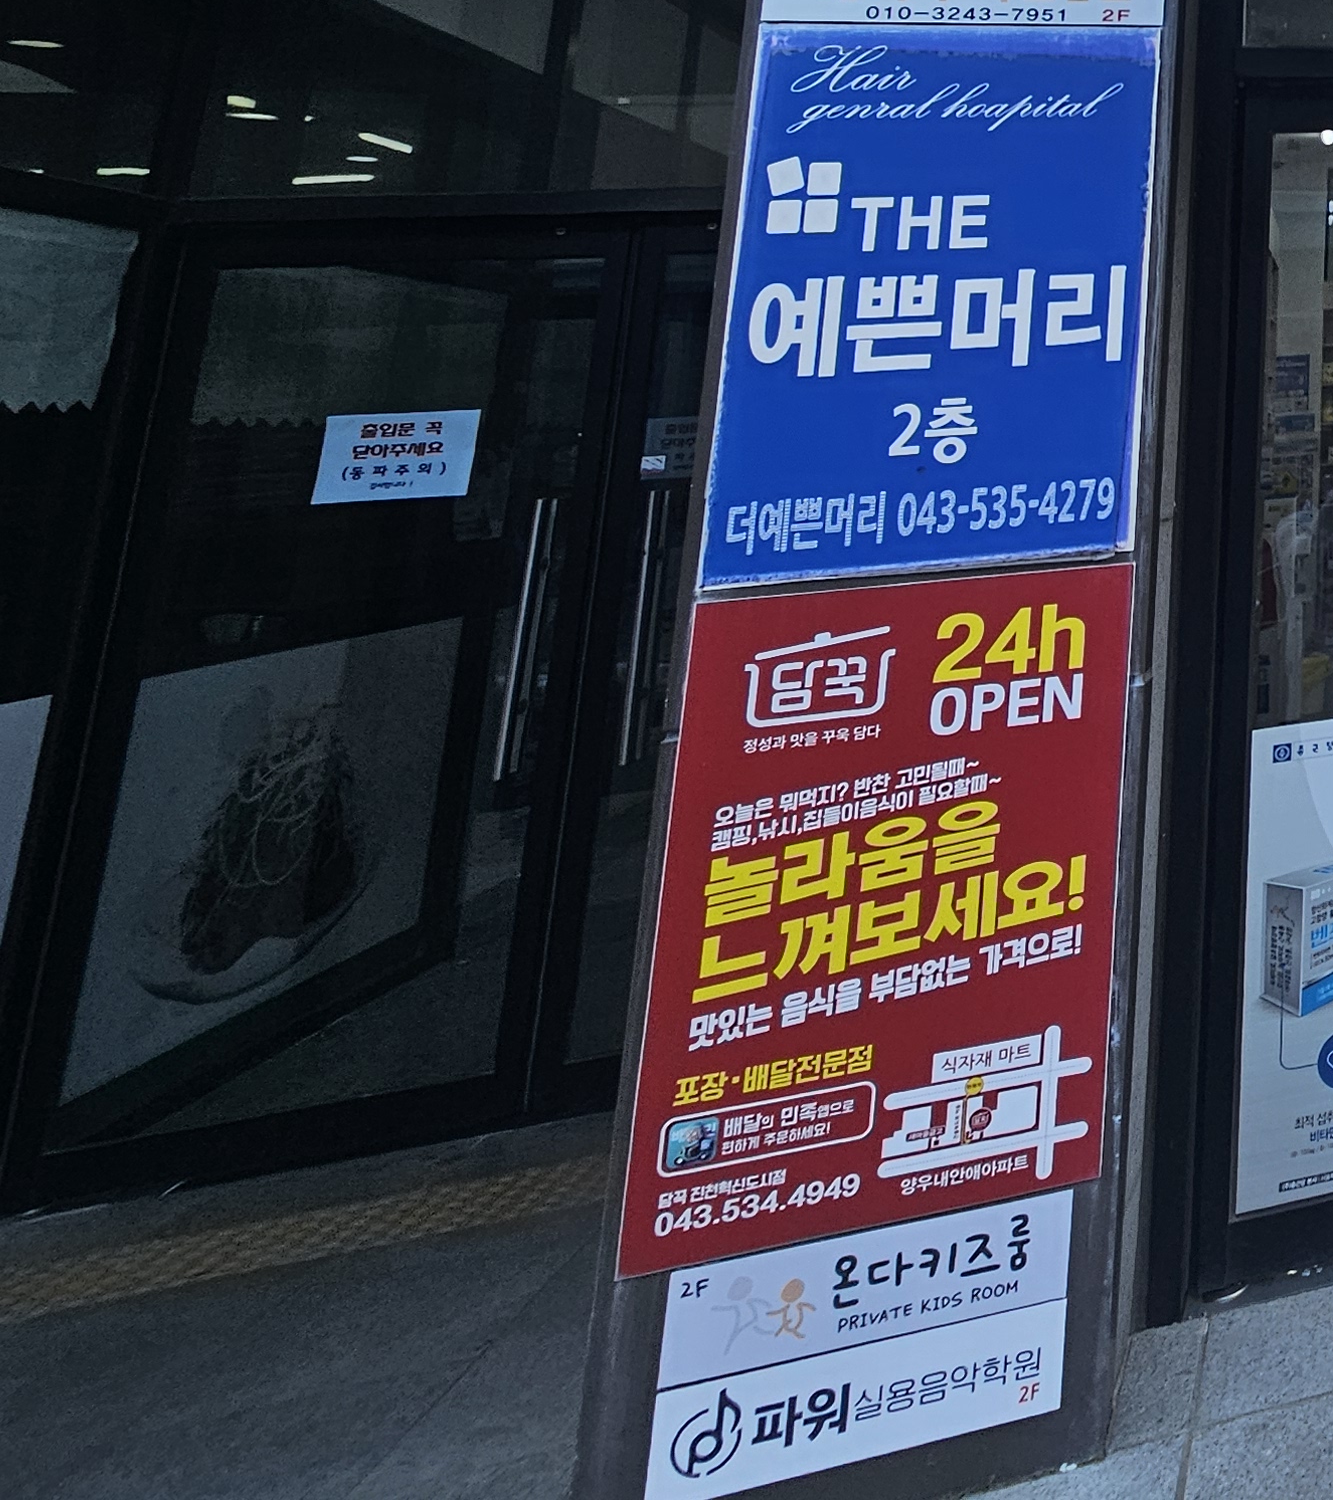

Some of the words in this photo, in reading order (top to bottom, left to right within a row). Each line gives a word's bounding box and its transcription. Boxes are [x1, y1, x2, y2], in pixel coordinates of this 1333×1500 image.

[865, 4, 1069, 24] 010-3243-7951
[1101, 6, 1131, 24] 2F
[790, 44, 917, 93] Hair
[850, 193, 991, 252] THE
[748, 264, 1128, 378] 예쁜머리
[351, 441, 444, 460] 닫아주세요
[360, 422, 416, 439] 출입문
[425, 420, 444, 435] 꼭
[887, 397, 978, 464] 2층
[725, 490, 887, 556] 더예쁜머리
[896, 476, 1116, 538] 043-535-4279
[932, 603, 1086, 684] 24h
[929, 672, 1085, 736] OPEN
[743, 734, 787, 754] 정성과
[790, 731, 818, 749] 맛을
[821, 727, 850, 745] 꾸욱
[853, 723, 882, 741] 담다
[714, 796, 774, 829] 오늘은
[778, 782, 850, 813] 뭐먹지?
[853, 772, 892, 799] 반찬
[704, 799, 1000, 929] 놀라움을
[691, 854, 1087, 1005] 느껴보세요!
[687, 1001, 773, 1052] 맛있는
[780, 977, 862, 1029] 음식을
[868, 954, 972, 1004] 부담없는
[978, 923, 1084, 977] 가격으로!
[941, 1049, 993, 1075] 식자재
[998, 1043, 1032, 1064] 마트
[721, 1135, 761, 1156] 편하게
[763, 1121, 831, 1147] 주문하세요!
[722, 1112, 775, 1139] 배달의
[1294, 1114, 1315, 1130] 최적
[688, 1168, 788, 1204] 진천혁신도시점
[900, 1153, 1030, 1196] 양우내안애아파트
[652, 1172, 862, 1238] 043.534.4949
[680, 1277, 710, 1299] 2F
[832, 1212, 1031, 1310] 온다키즈룸
[837, 1302, 914, 1334] PRIVATE
[919, 1292, 964, 1317] KIDS
[970, 1280, 1019, 1305] ROOM
[750, 1346, 1043, 1450] 파워실용음악학원
[1018, 1382, 1040, 1405] 2F
